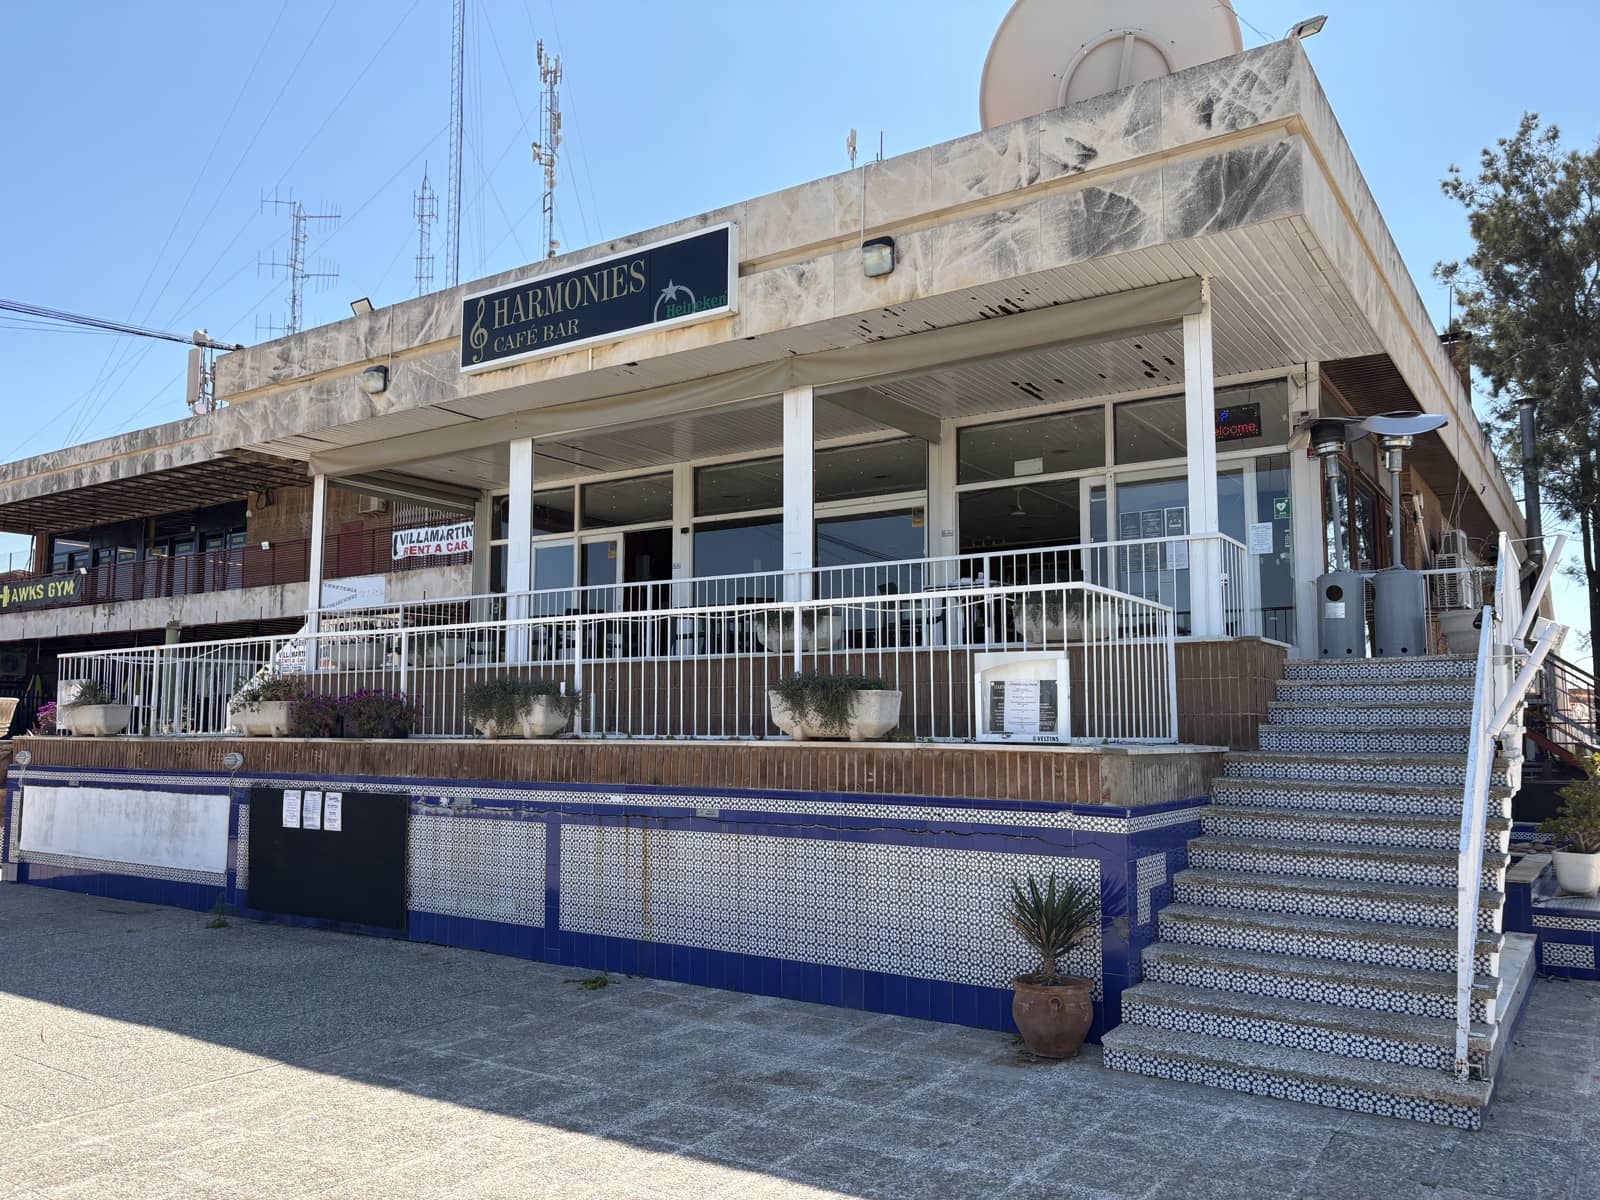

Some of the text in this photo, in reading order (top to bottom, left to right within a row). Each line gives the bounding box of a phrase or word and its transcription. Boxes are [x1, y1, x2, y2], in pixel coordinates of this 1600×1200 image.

[493, 258, 646, 330] HARMONIES
[667, 294, 728, 318] Heineken
[494, 319, 580, 352] CAFÉ BAR
[400, 525, 473, 546] VILLAMARTIN
[403, 540, 468, 556] RENT A CAR
[48, 580, 74, 598] GYM
